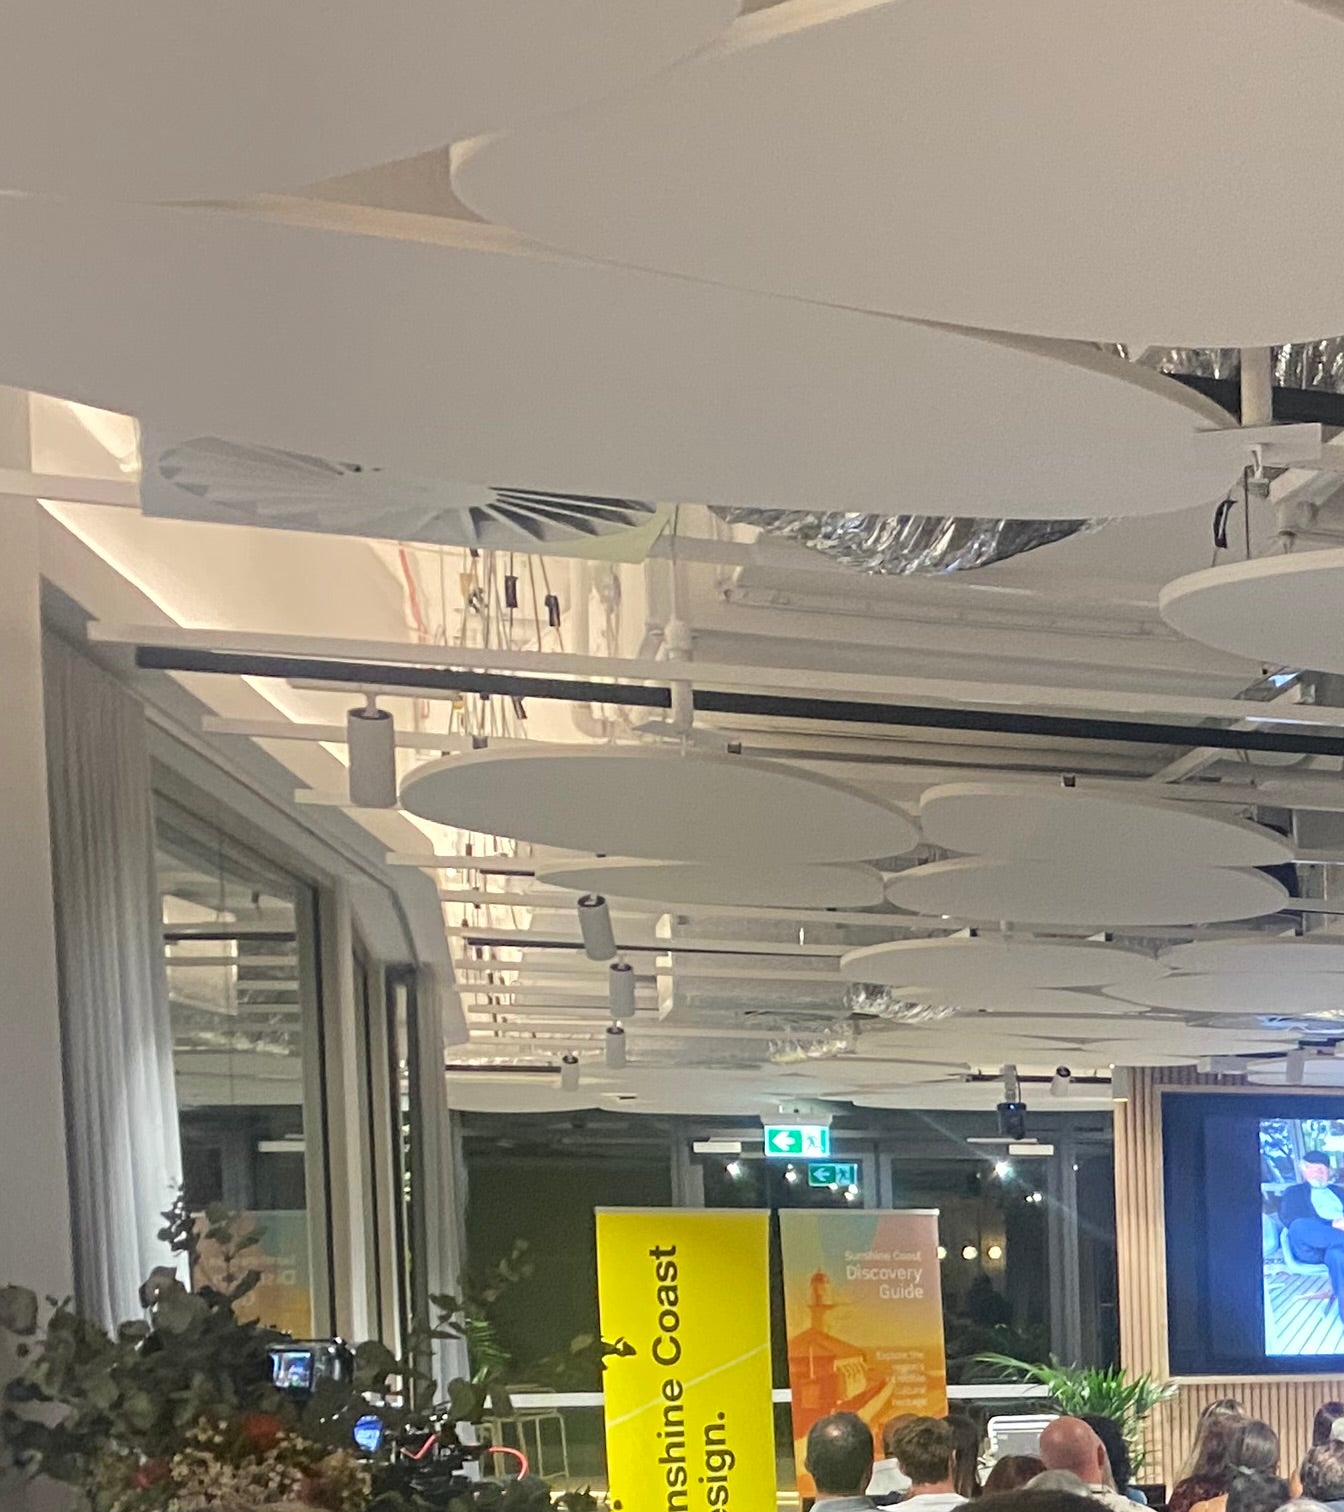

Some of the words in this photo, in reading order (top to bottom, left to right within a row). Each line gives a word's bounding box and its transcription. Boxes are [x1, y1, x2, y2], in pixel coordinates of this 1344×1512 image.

[845, 1263, 923, 1284] Discovery
[879, 1283, 924, 1299] Guide
[649, 1244, 682, 1367] Coast
